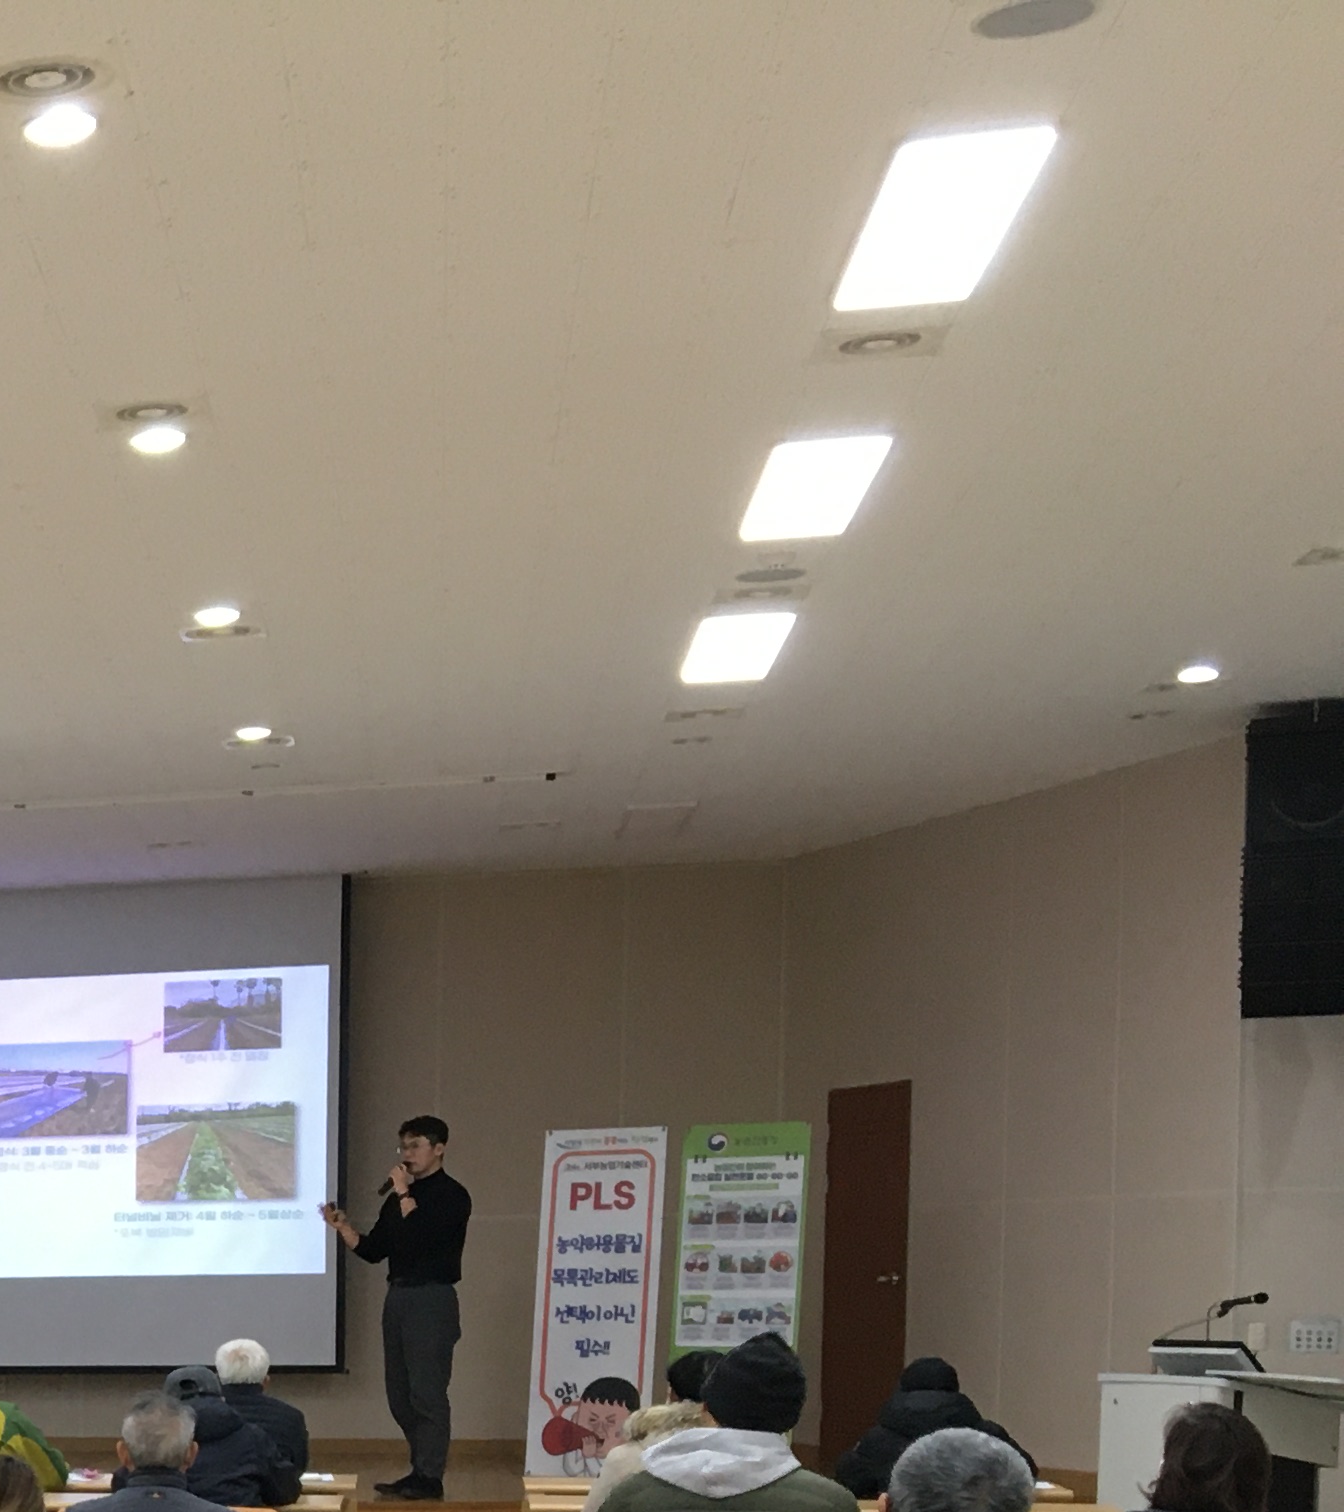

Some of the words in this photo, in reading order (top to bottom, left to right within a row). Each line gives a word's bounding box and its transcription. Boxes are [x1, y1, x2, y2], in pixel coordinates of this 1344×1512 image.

[570, 1181, 635, 1210] PLS
[556, 1233, 642, 1254] 농약허용물질
[552, 1267, 639, 1287] 목록관리제도
[555, 1304, 601, 1324] 선택이
[603, 1304, 635, 1324] 아닌
[575, 1338, 610, 1357] 필수!!
